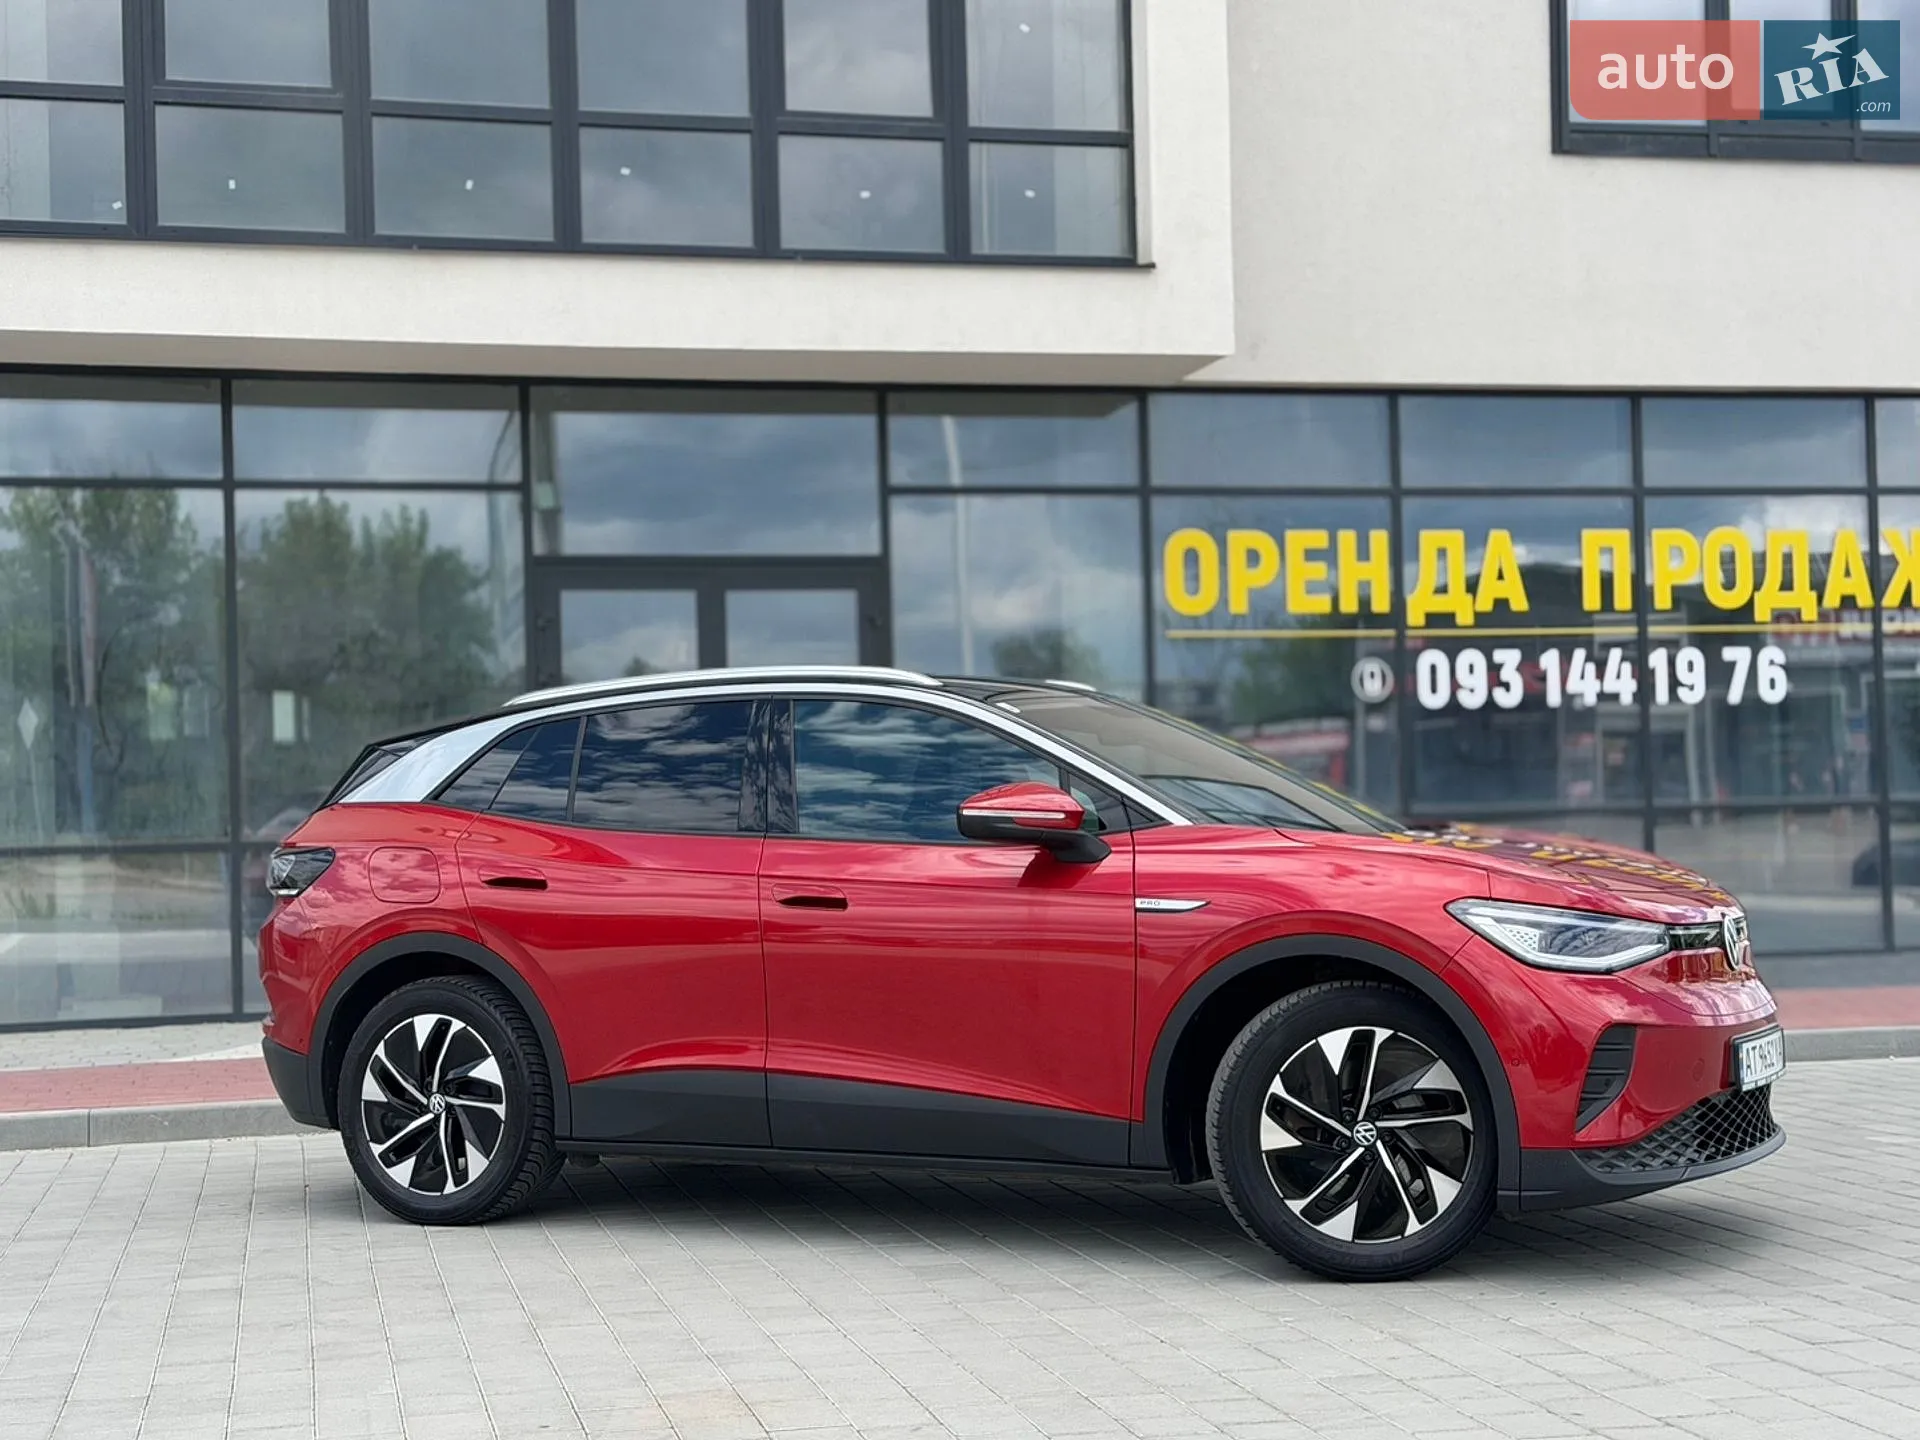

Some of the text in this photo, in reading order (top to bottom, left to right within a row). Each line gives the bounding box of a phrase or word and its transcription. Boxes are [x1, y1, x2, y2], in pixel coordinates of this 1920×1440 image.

[1163, 527, 1530, 627] ОРЕНДА
[1415, 645, 1788, 710] 093 144 19 76
